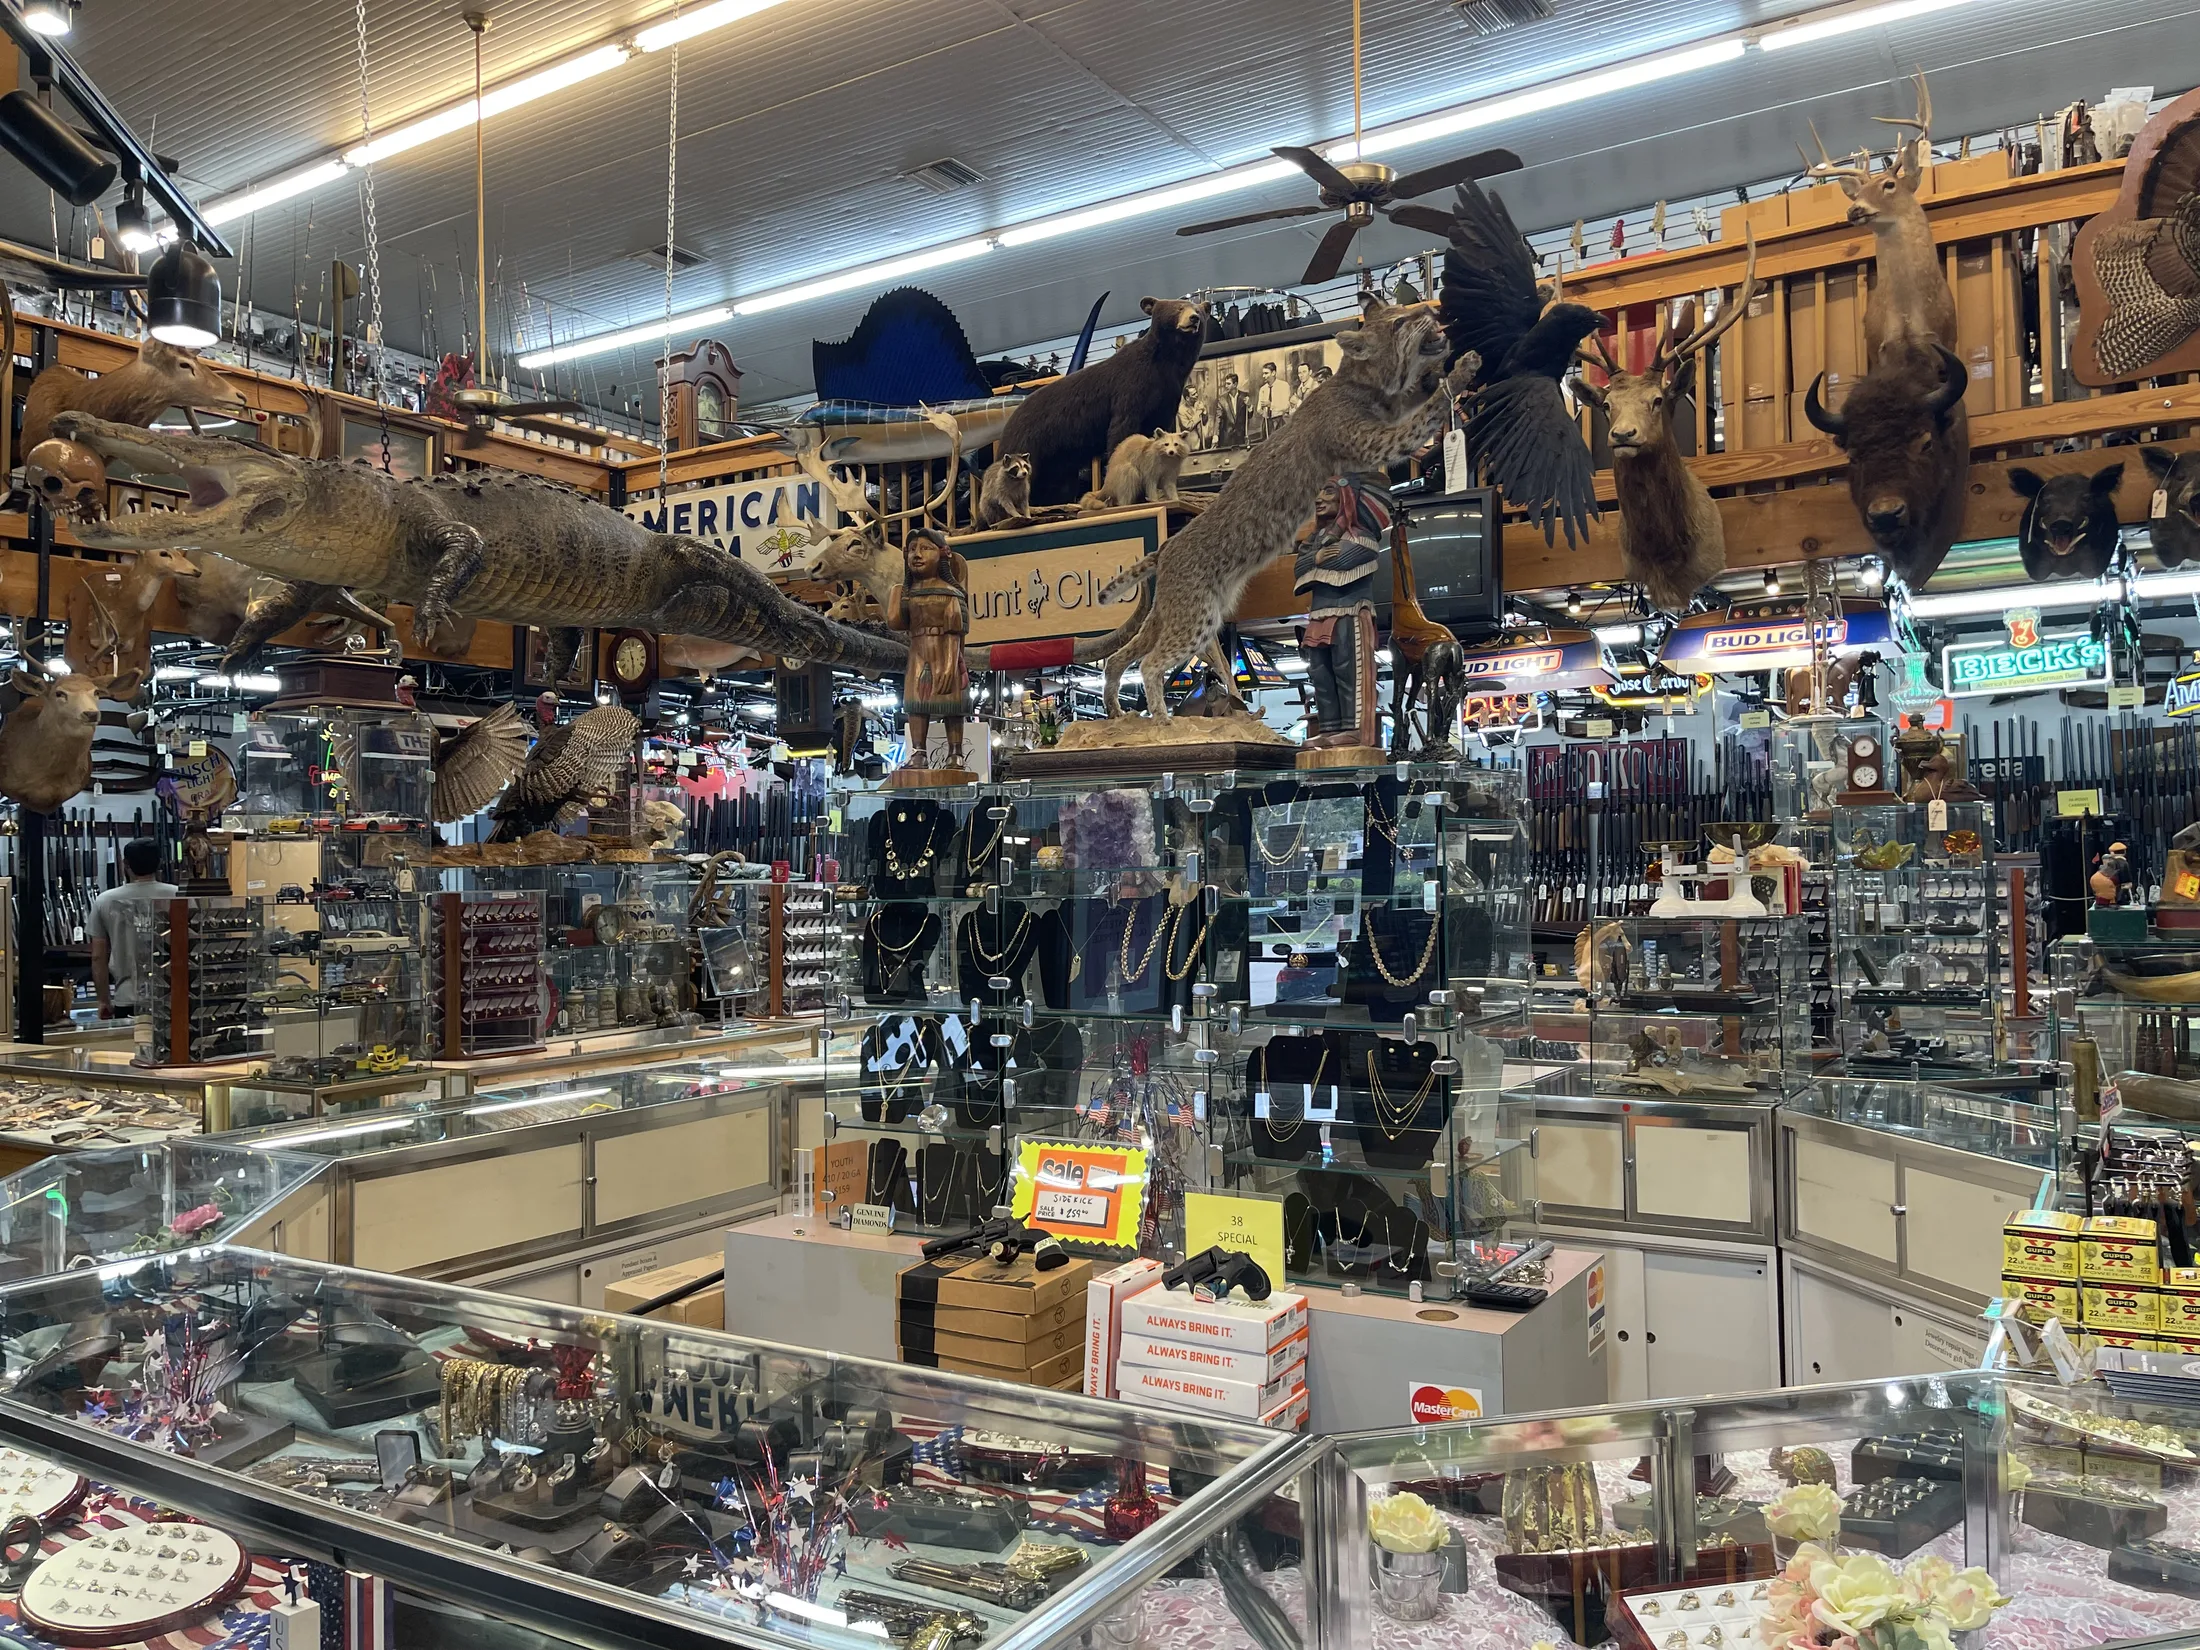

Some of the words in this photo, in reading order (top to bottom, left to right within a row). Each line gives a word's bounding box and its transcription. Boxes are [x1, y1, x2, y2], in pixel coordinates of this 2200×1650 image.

[1711, 634, 1762, 648] BUD
[1766, 626, 1838, 644] LIGHT
[1464, 662, 1490, 675] UD
[1493, 654, 1556, 671] LIGHT
[830, 1157, 853, 1168] YOUTH
[842, 1171, 850, 1180] 20
[851, 1169, 861, 1178] GA
[1041, 1158, 1084, 1186] Sale
[856, 1208, 886, 1218] GENUINE
[853, 1218, 887, 1228] DIAMONDS
[1230, 1215, 1243, 1227] 38
[1217, 1231, 1258, 1246] SPECIAL
[2026, 1247, 2053, 1255] SUPER
[2103, 1252, 2131, 1260] SUPER
[2007, 1256, 2018, 1264] 22
[643, 1264, 658, 1272] Papers
[2088, 1309, 2099, 1317] 22
[1146, 1315, 1187, 1331] ALWAYS
[1188, 1322, 1219, 1336] BRING
[2165, 1317, 2176, 1325] 22
[1090, 1333, 1101, 1365] BRING
[1146, 1344, 1188, 1360] ALWAYS
[1189, 1351, 1220, 1365] BRING
[1141, 1374, 1181, 1391] ALWAYS
[1183, 1382, 1212, 1397] BRING
[1413, 1401, 1479, 1418] MasterCard
